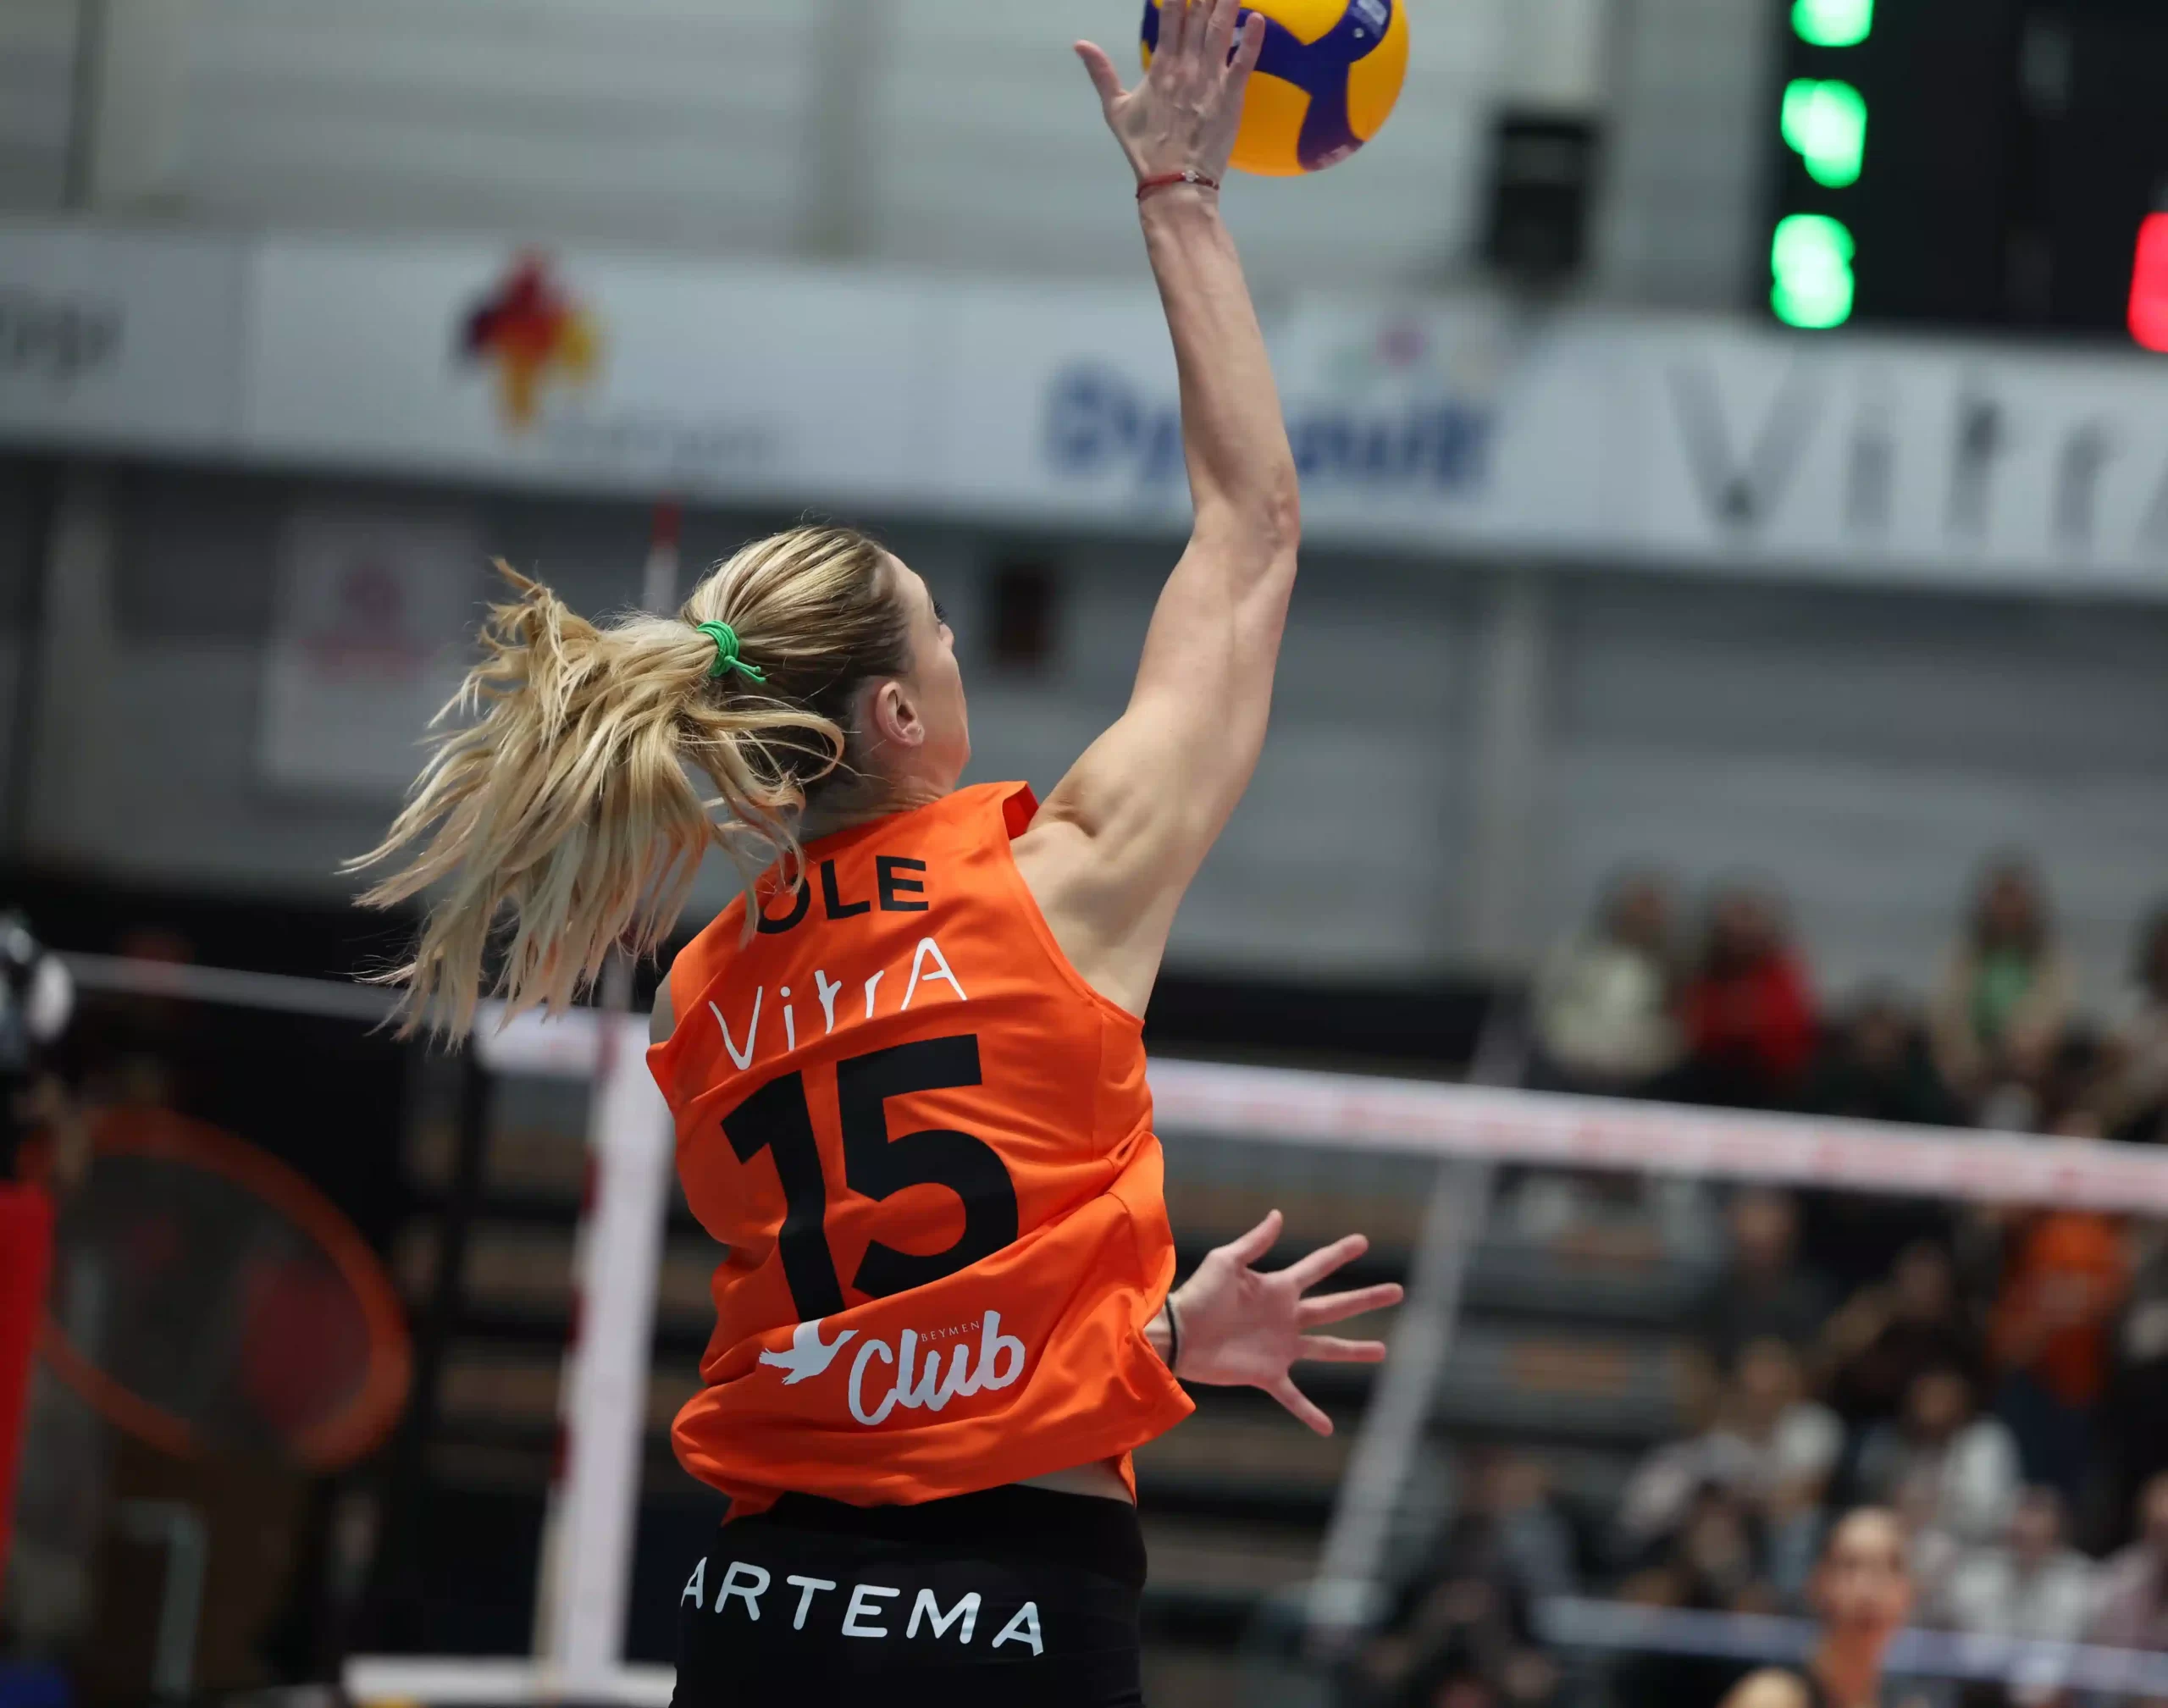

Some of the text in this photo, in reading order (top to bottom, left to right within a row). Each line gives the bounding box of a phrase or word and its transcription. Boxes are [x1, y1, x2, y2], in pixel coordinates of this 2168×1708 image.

[709, 937, 968, 1070] VitrA
[720, 1033, 1019, 1323] 15
[848, 1310, 1026, 1426] Club
[921, 1321, 980, 1342] BEYMEN
[680, 1556, 1043, 1656] ARTEMA
